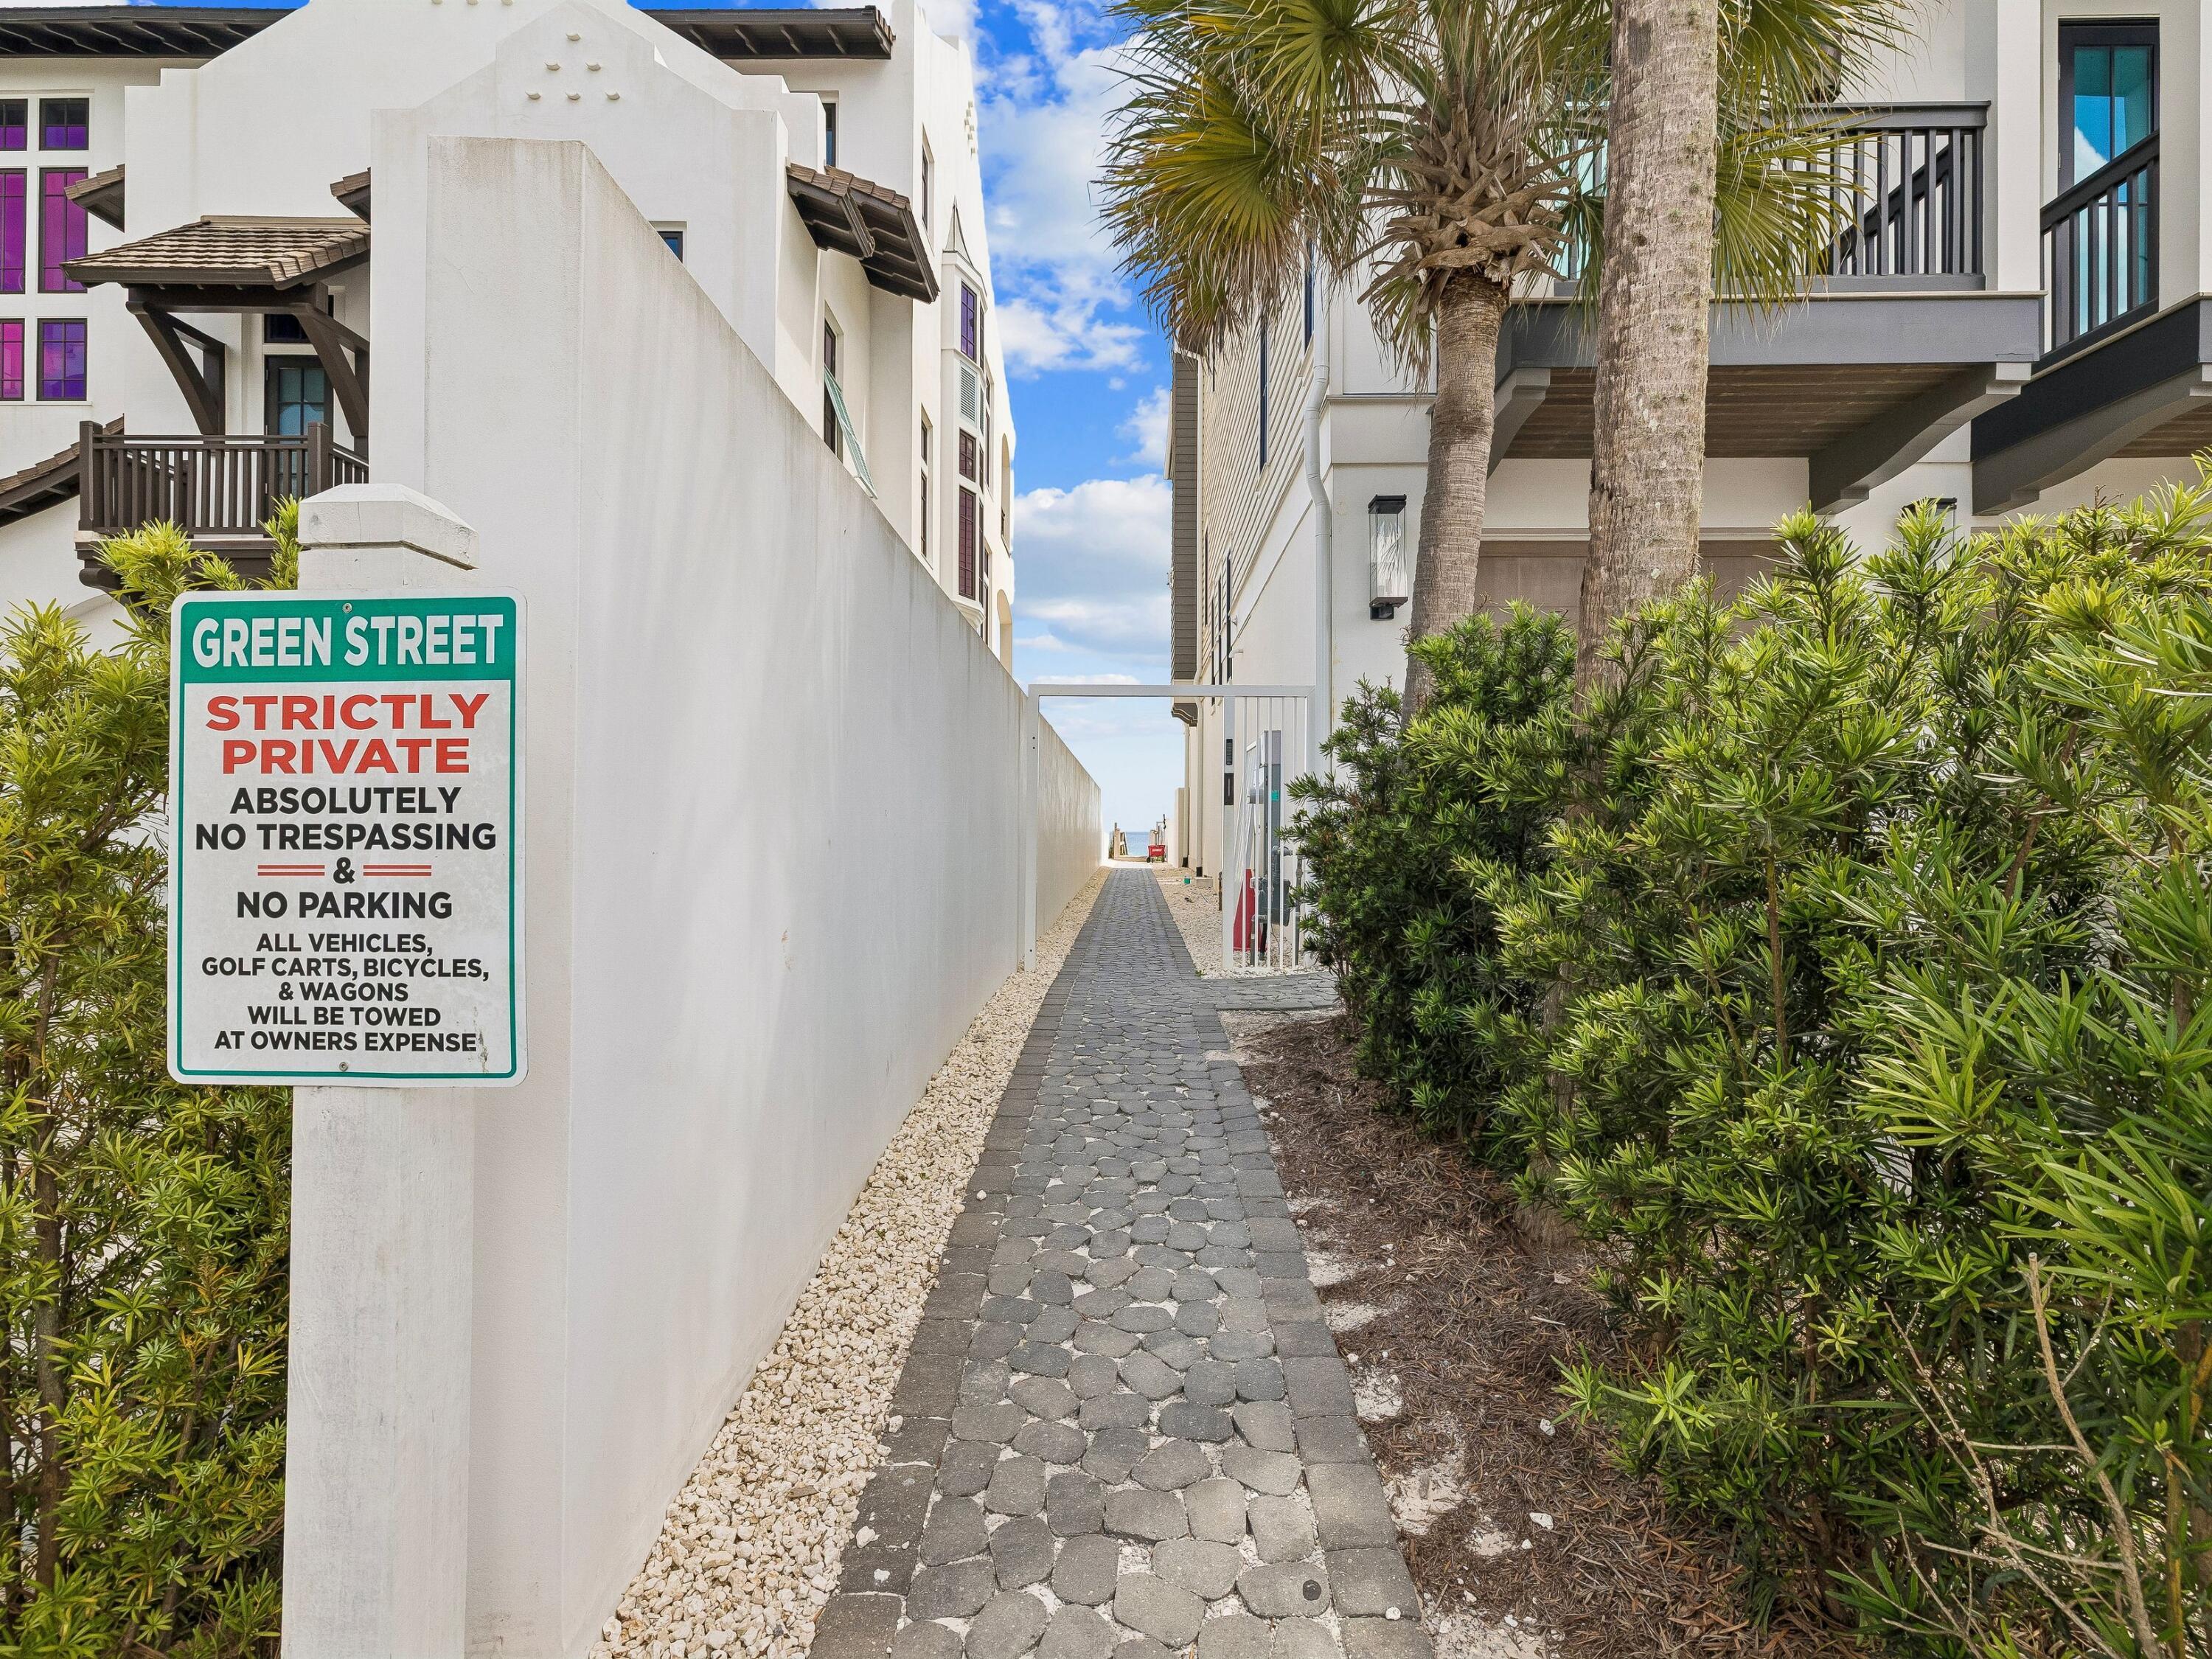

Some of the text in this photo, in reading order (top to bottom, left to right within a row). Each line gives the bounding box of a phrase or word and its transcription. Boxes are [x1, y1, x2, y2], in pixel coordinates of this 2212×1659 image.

[192, 613, 504, 667] GREEN STREET
[206, 694, 490, 731] STRICTLY
[223, 738, 470, 774] PRIVATE
[230, 787, 462, 814] ABSOLUTELY
[196, 823, 496, 850] NO TRESPASSING
[333, 858, 355, 883] &
[237, 891, 451, 919] NO PARKING
[256, 933, 432, 956] ALL VEHICLES,
[202, 957, 488, 981] GOLF CARTS, BICYCLES,
[278, 982, 408, 1001] & WAGONS
[248, 1006, 440, 1026] WILL BE TOWED
[215, 1031, 476, 1051] AT OWNERS EXPENSE
